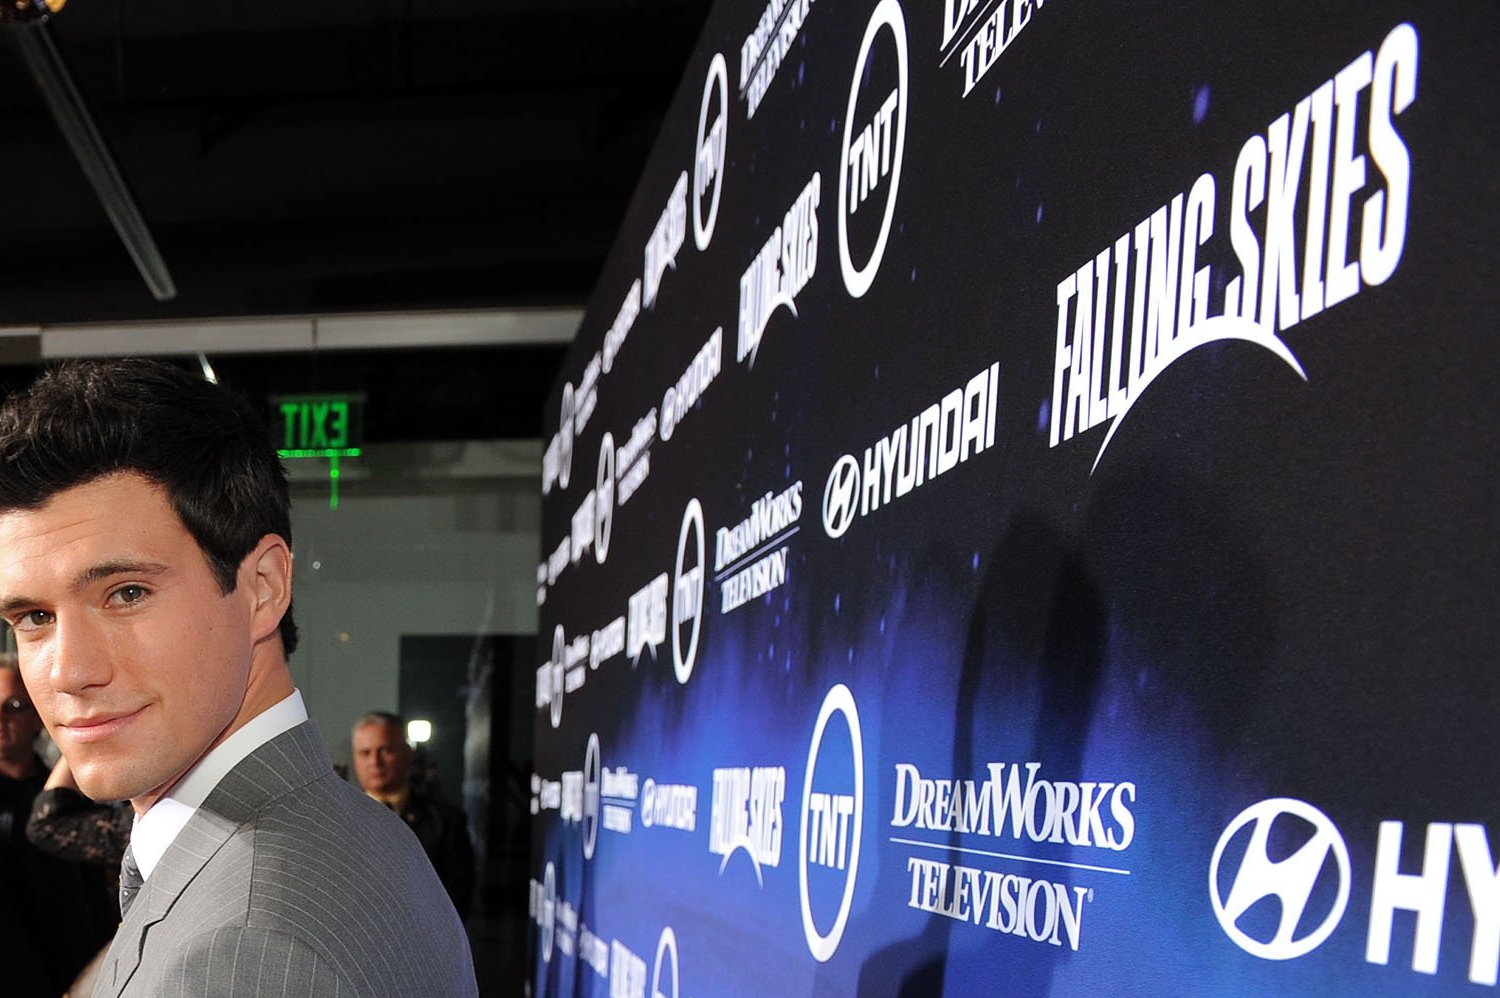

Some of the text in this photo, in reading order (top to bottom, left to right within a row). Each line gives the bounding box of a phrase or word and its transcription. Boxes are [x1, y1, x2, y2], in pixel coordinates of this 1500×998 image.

[848, 88, 898, 214] TNT
[1049, 22, 1420, 448] FALLING SKIES
[860, 362, 999, 517] HYUNDAI
[809, 793, 855, 870] TNT
[907, 857, 1088, 952] TELEVISION
